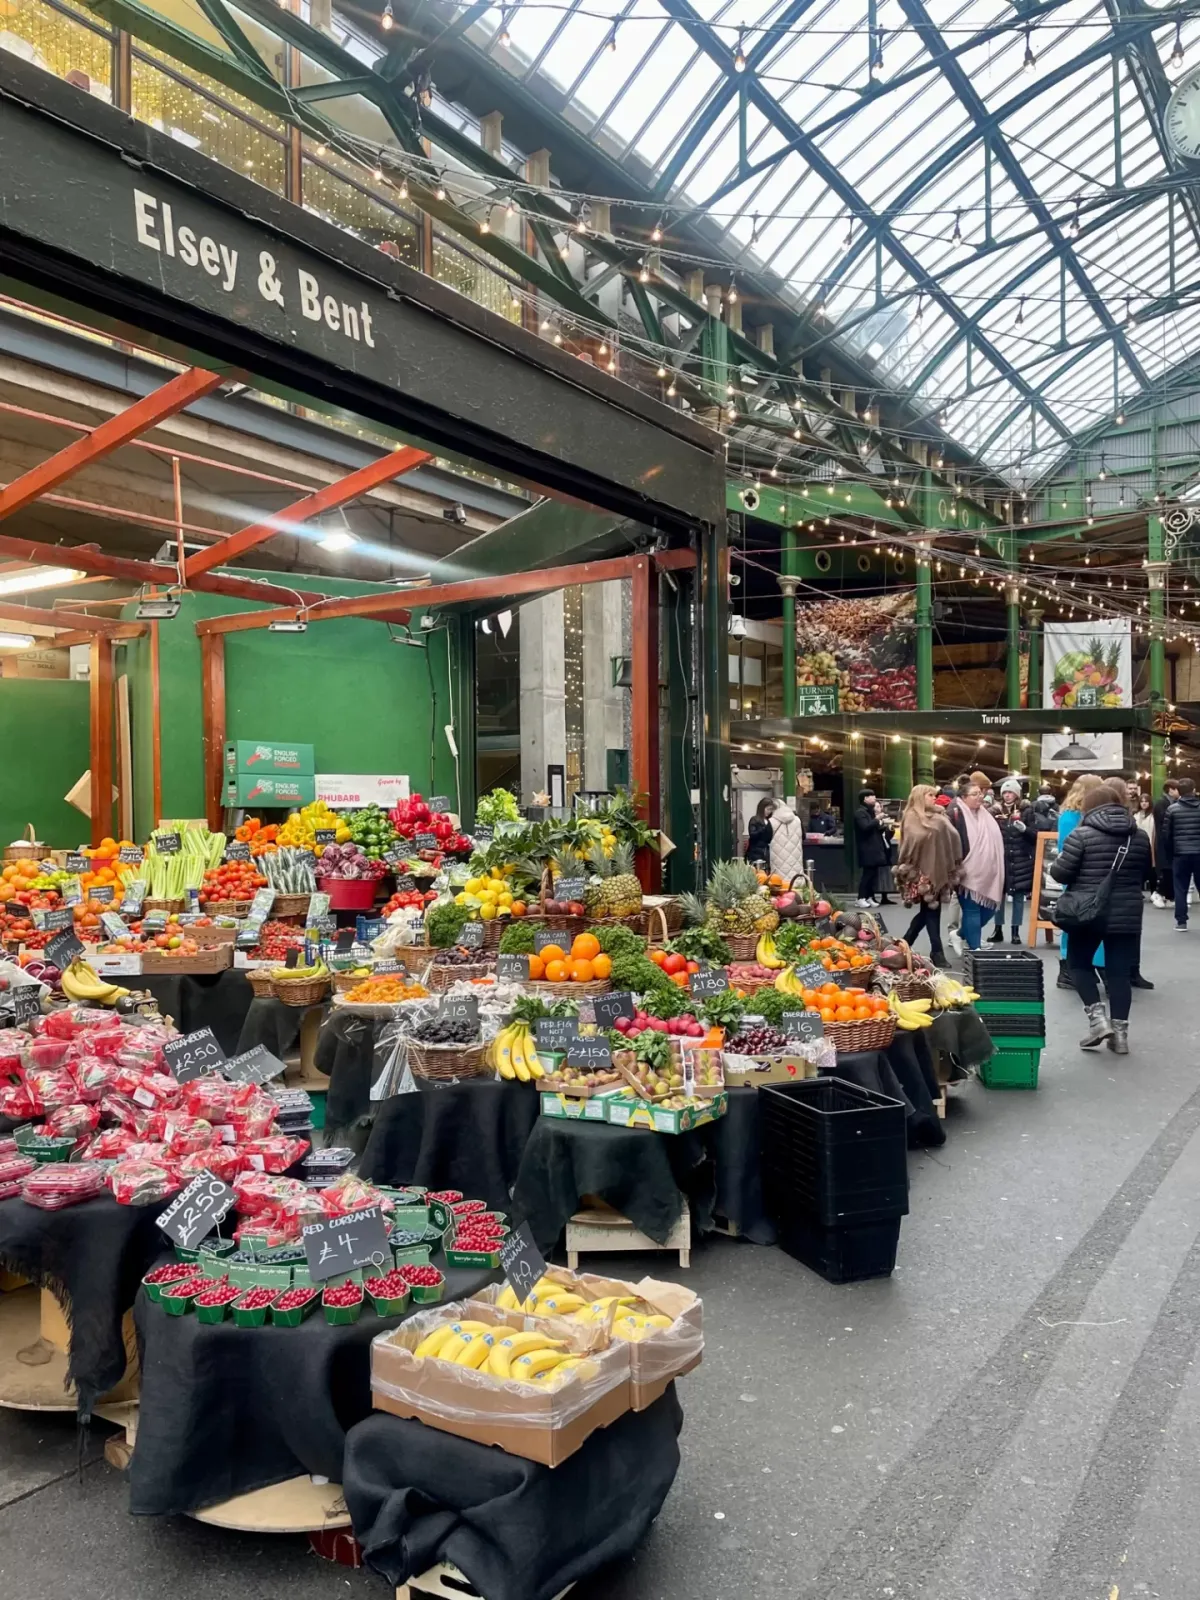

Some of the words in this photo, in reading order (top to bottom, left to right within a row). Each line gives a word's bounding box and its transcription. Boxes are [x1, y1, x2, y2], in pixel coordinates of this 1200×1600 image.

[133, 188, 238, 292] Elsey
[258, 251, 284, 307] &
[298, 268, 375, 348] Bent
[799, 686, 834, 695] TURNIPS
[981, 713, 1011, 725] Turnips
[318, 794, 361, 802] RHUBARB
[693, 971, 713, 979] MINT
[164, 1027, 215, 1054] STRAWBERRY
[175, 1043, 218, 1077] £2.50
[155, 1168, 217, 1229] BLUEBERRY
[177, 1181, 226, 1247] £2.50
[302, 1223, 325, 1237] RED
[500, 1230, 523, 1260] SINGLE
[397, 1248, 428, 1257] berrybrthers
[206, 1259, 229, 1268] berrybrthers
[230, 1264, 257, 1272] berrybrthers
